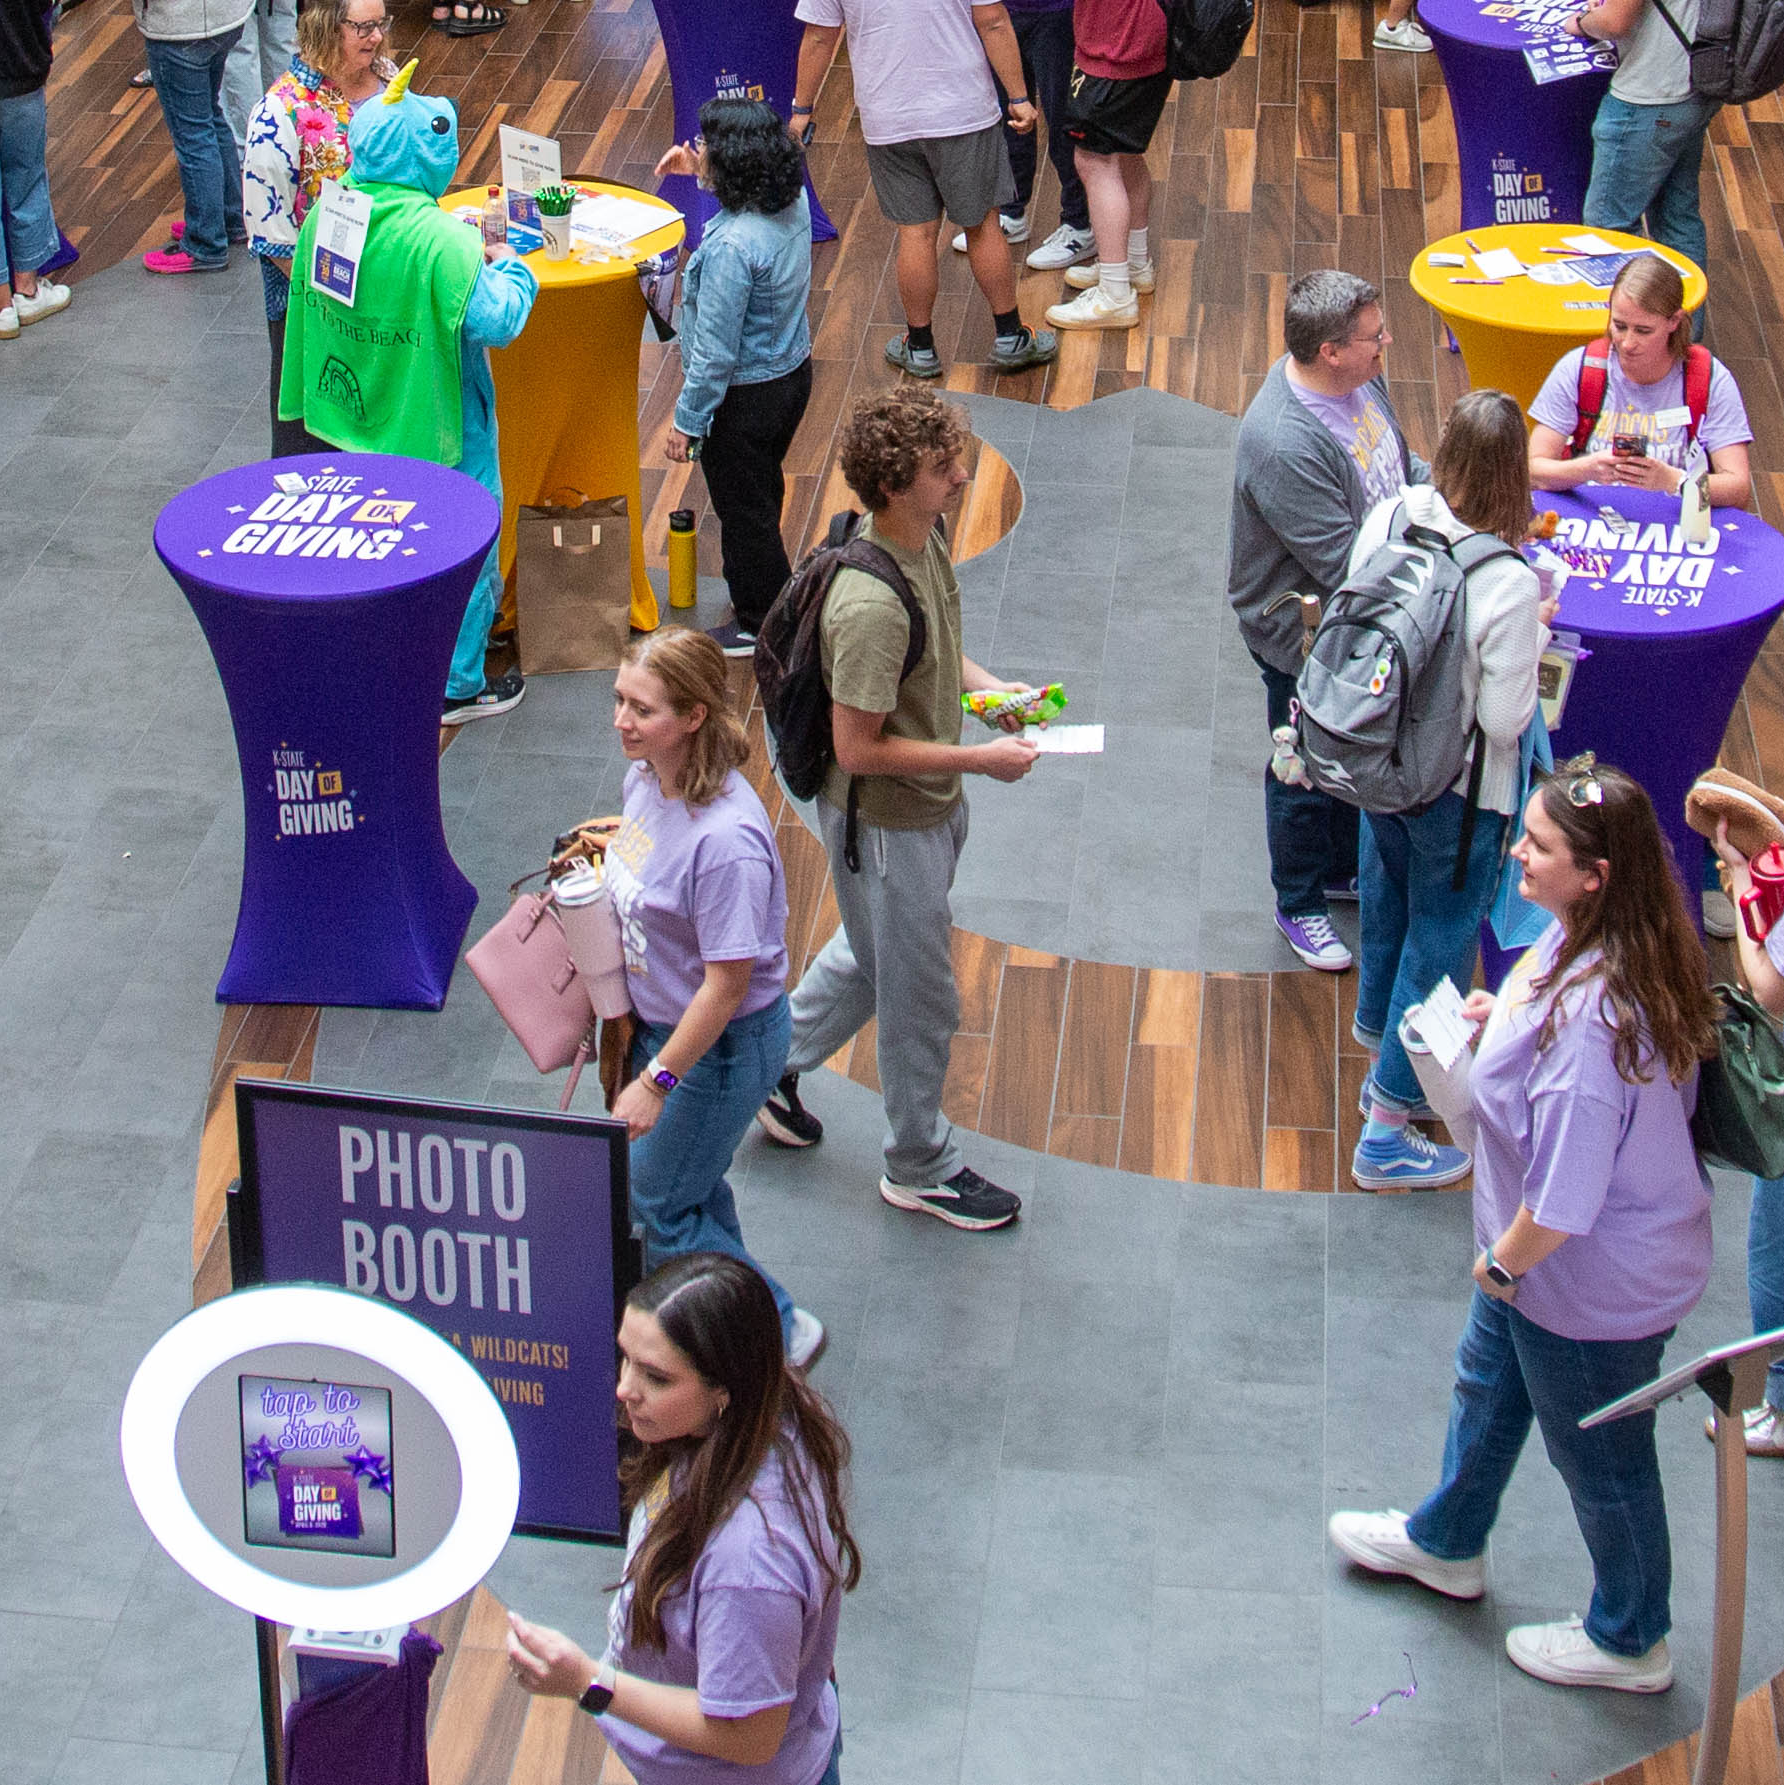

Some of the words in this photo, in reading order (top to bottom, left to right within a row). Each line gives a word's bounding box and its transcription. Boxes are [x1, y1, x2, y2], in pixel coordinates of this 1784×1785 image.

[1494, 173, 1523, 197] DAY
[1528, 178, 1540, 190] OF
[1495, 196, 1551, 224] GIVING
[336, 318, 366, 343] THE
[306, 475, 364, 493] STATE
[247, 491, 365, 524] DAY
[221, 522, 405, 561] GIVING
[1612, 554, 1716, 588] DAY
[1622, 586, 1705, 608] K-STATE
[272, 749, 306, 768] K-STATE
[275, 769, 315, 801] DAY
[322, 774, 337, 792] OF
[279, 799, 355, 836] GIVING
[339, 1125, 526, 1222] PHOTO
[342, 1219, 532, 1314] BOOTH
[471, 1335, 570, 1370] WILDCATS!
[261, 1385, 316, 1425] tap
[324, 1384, 360, 1414] to
[489, 1378, 545, 1407] IVING
[279, 1416, 360, 1451] start
[293, 1485, 320, 1504] DAY
[294, 1503, 342, 1522] GIVING
